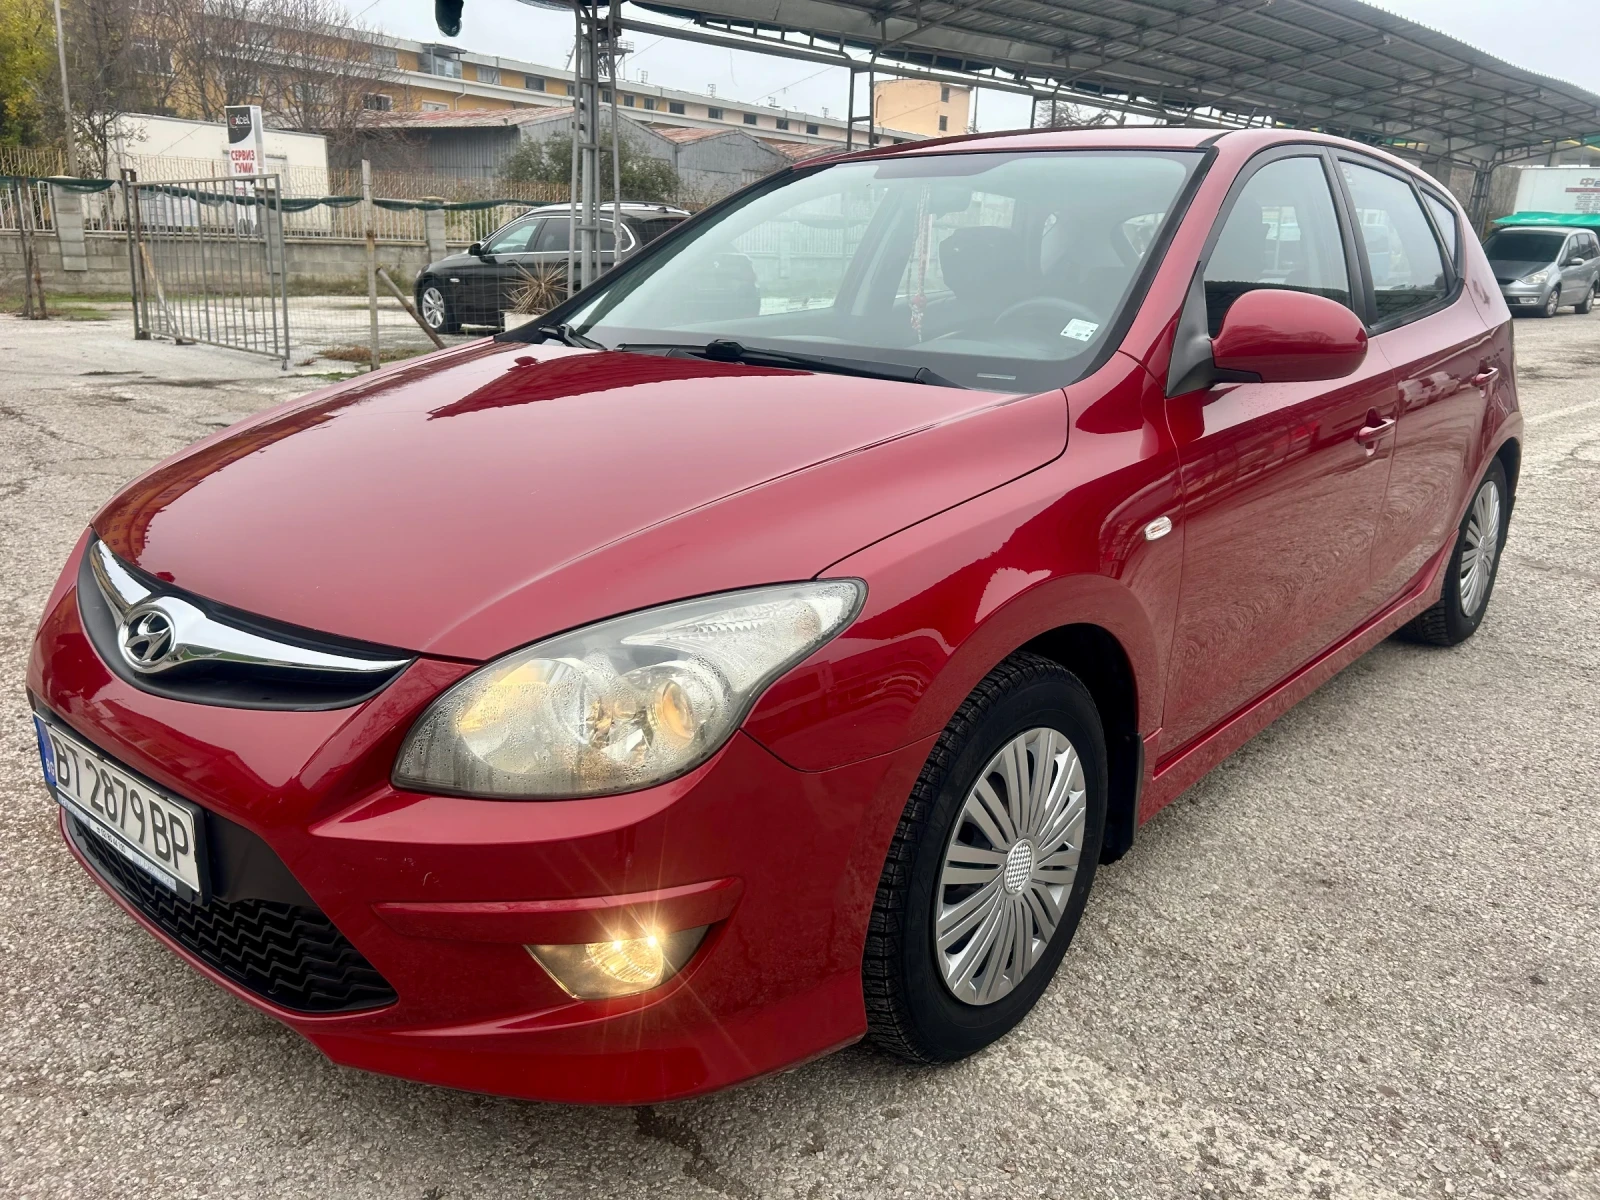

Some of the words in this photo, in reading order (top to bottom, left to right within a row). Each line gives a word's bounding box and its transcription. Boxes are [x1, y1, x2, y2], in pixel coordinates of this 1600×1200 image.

[231, 149, 255, 161] СЕРВИЗ
[235, 162, 253, 173] ГУМИ
[45, 757, 55, 777] BG
[50, 732, 81, 798] BT
[85, 758, 146, 845] 2879
[149, 797, 189, 871] BP
